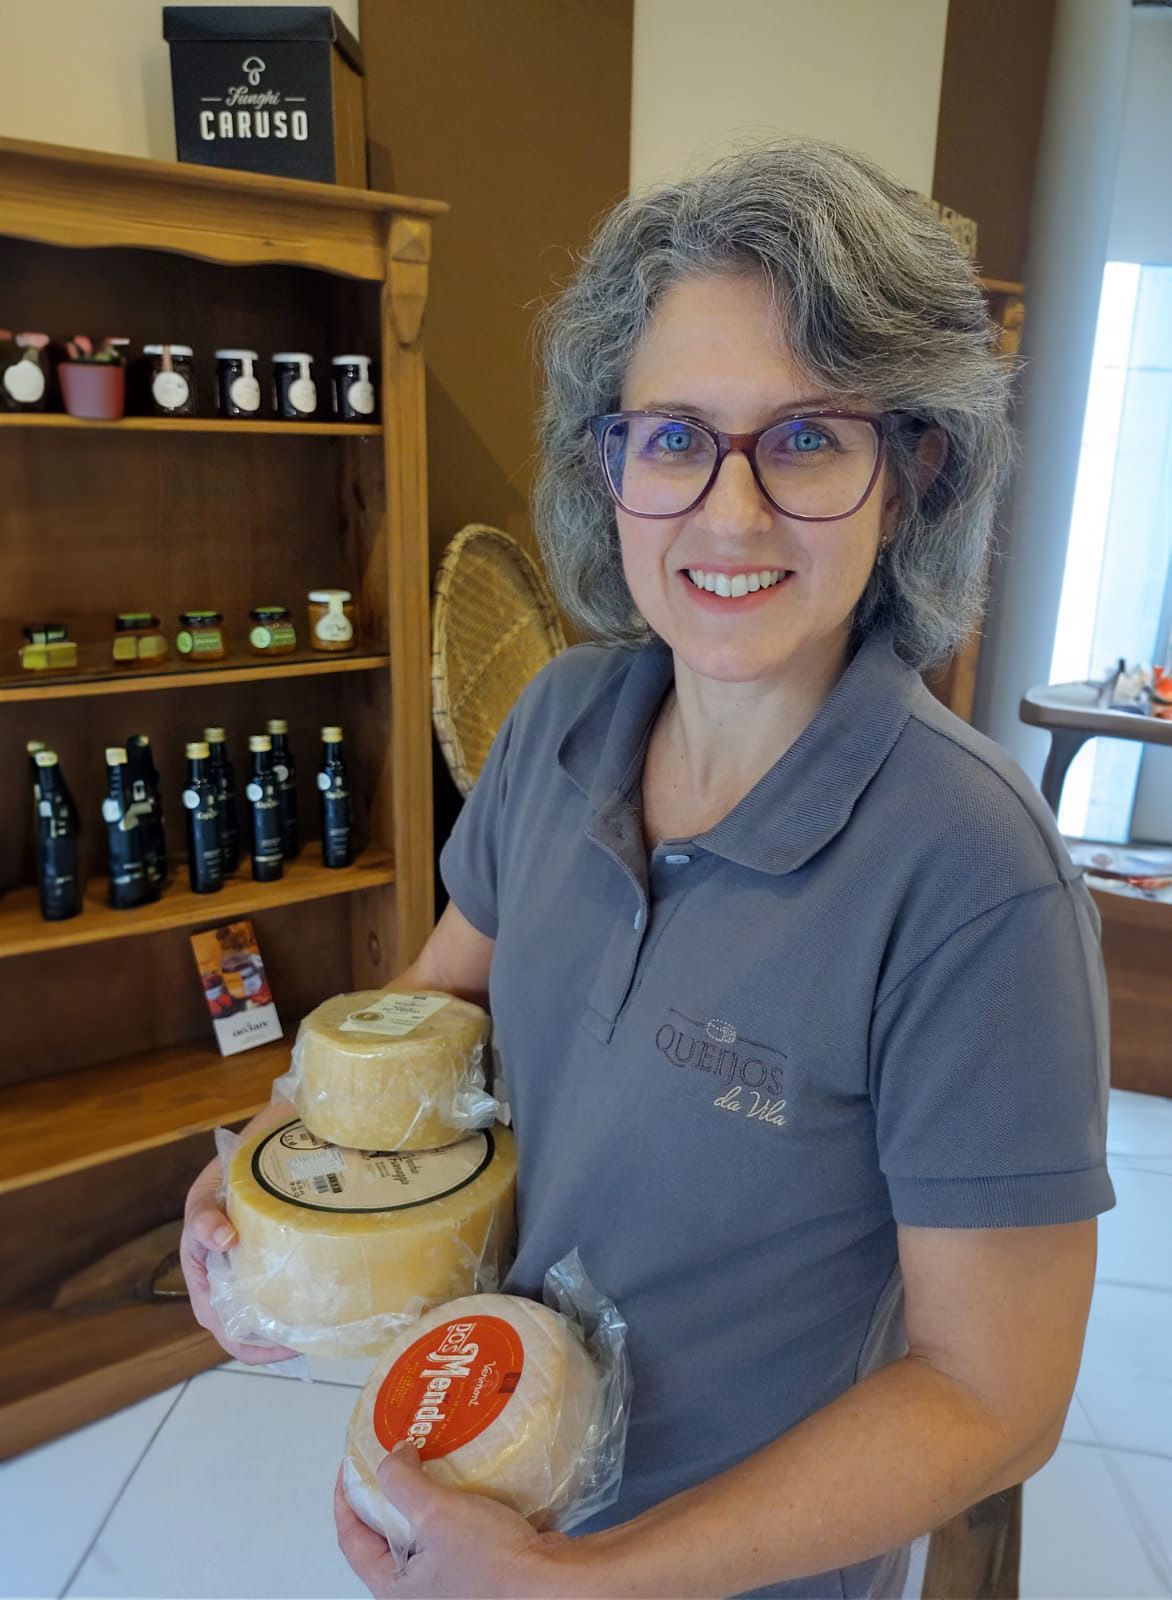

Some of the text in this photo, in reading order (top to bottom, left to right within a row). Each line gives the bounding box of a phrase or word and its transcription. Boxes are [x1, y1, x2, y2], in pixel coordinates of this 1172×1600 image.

[225, 86, 280, 109] Funghi
[199, 110, 309, 141] CARUSO
[655, 1023, 784, 1095] QUEIJOS
[713, 1086, 787, 1126] da Vila
[441, 1322, 476, 1353] DOS
[406, 1343, 479, 1449] Mendes
[468, 1361, 497, 1407] Vermont
